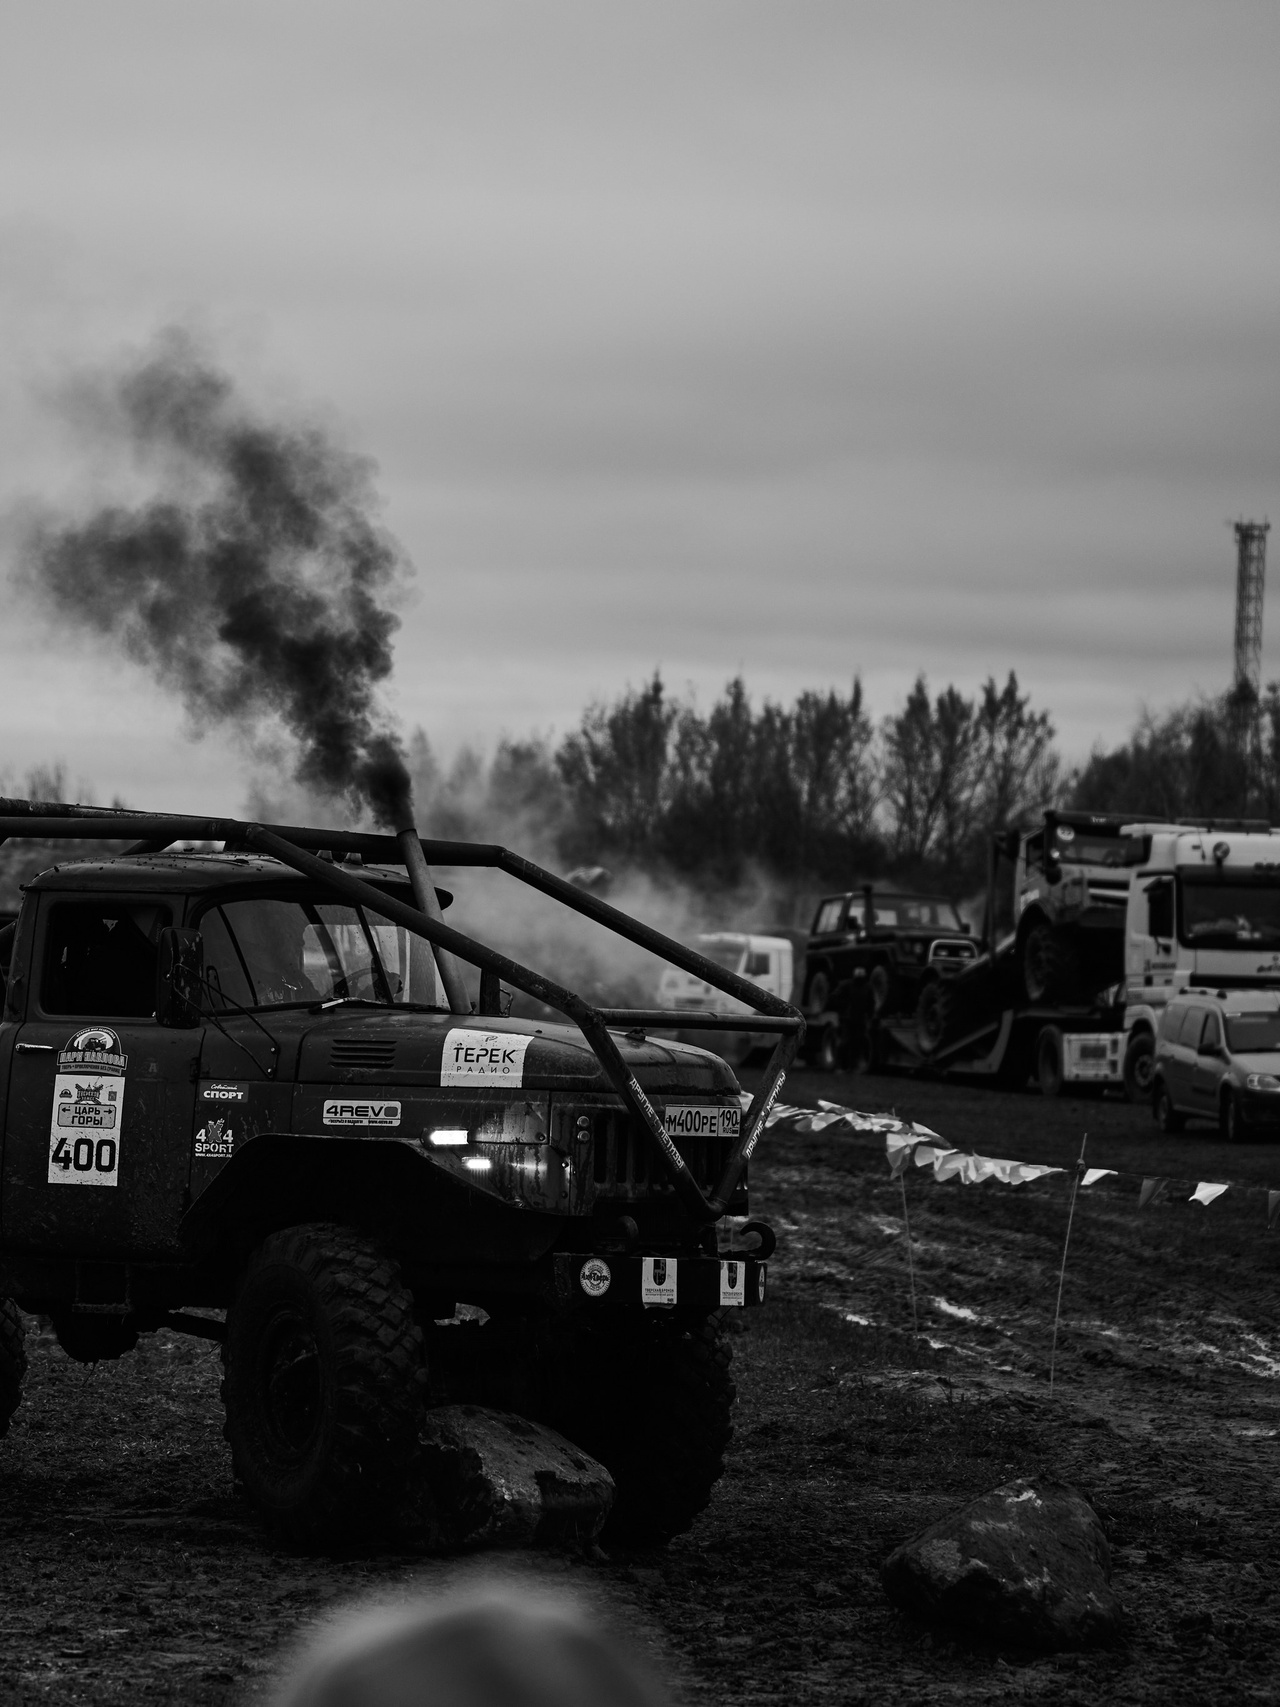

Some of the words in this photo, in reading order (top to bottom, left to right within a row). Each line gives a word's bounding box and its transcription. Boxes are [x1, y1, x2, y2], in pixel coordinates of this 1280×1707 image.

[454, 1047, 516, 1064] ТЕРЕК
[456, 1066, 511, 1075] РАДИО
[203, 1090, 244, 1099] СПОРТ
[74, 1106, 101, 1115] ЦАРЬ
[71, 1115, 103, 1126] ГОРЫ
[667, 1109, 717, 1133] М400РЕ
[720, 1109, 738, 1127] 190
[195, 1143, 234, 1153] SPORT
[658, 1126, 685, 1169] МЕТИЗЫ
[51, 1137, 116, 1172] 400
